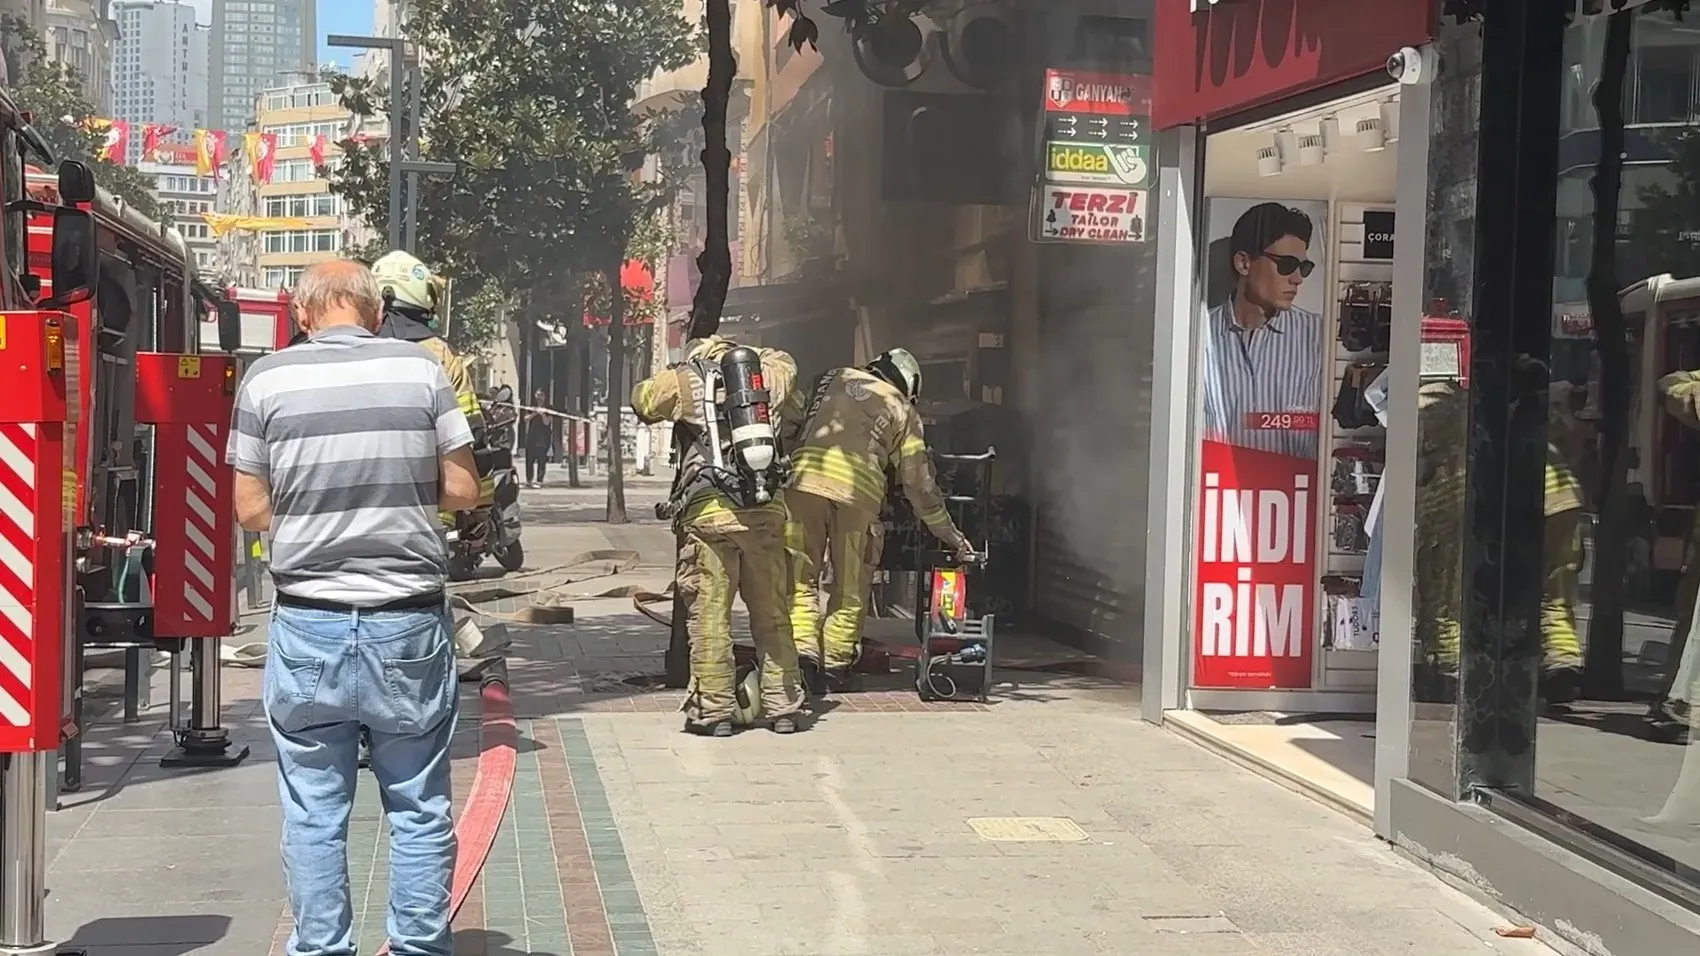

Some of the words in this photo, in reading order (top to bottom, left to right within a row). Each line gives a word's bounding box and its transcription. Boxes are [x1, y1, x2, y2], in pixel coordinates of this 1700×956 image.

[1051, 147, 1108, 171] iddaa
[1051, 191, 1139, 214] TERZİ
[1060, 227, 1085, 238] DRY
[1087, 228, 1129, 240] CLEAN
[1261, 414, 1291, 429] 249
[1203, 472, 1309, 563] İNDİ
[1201, 567, 1304, 657] RİM
